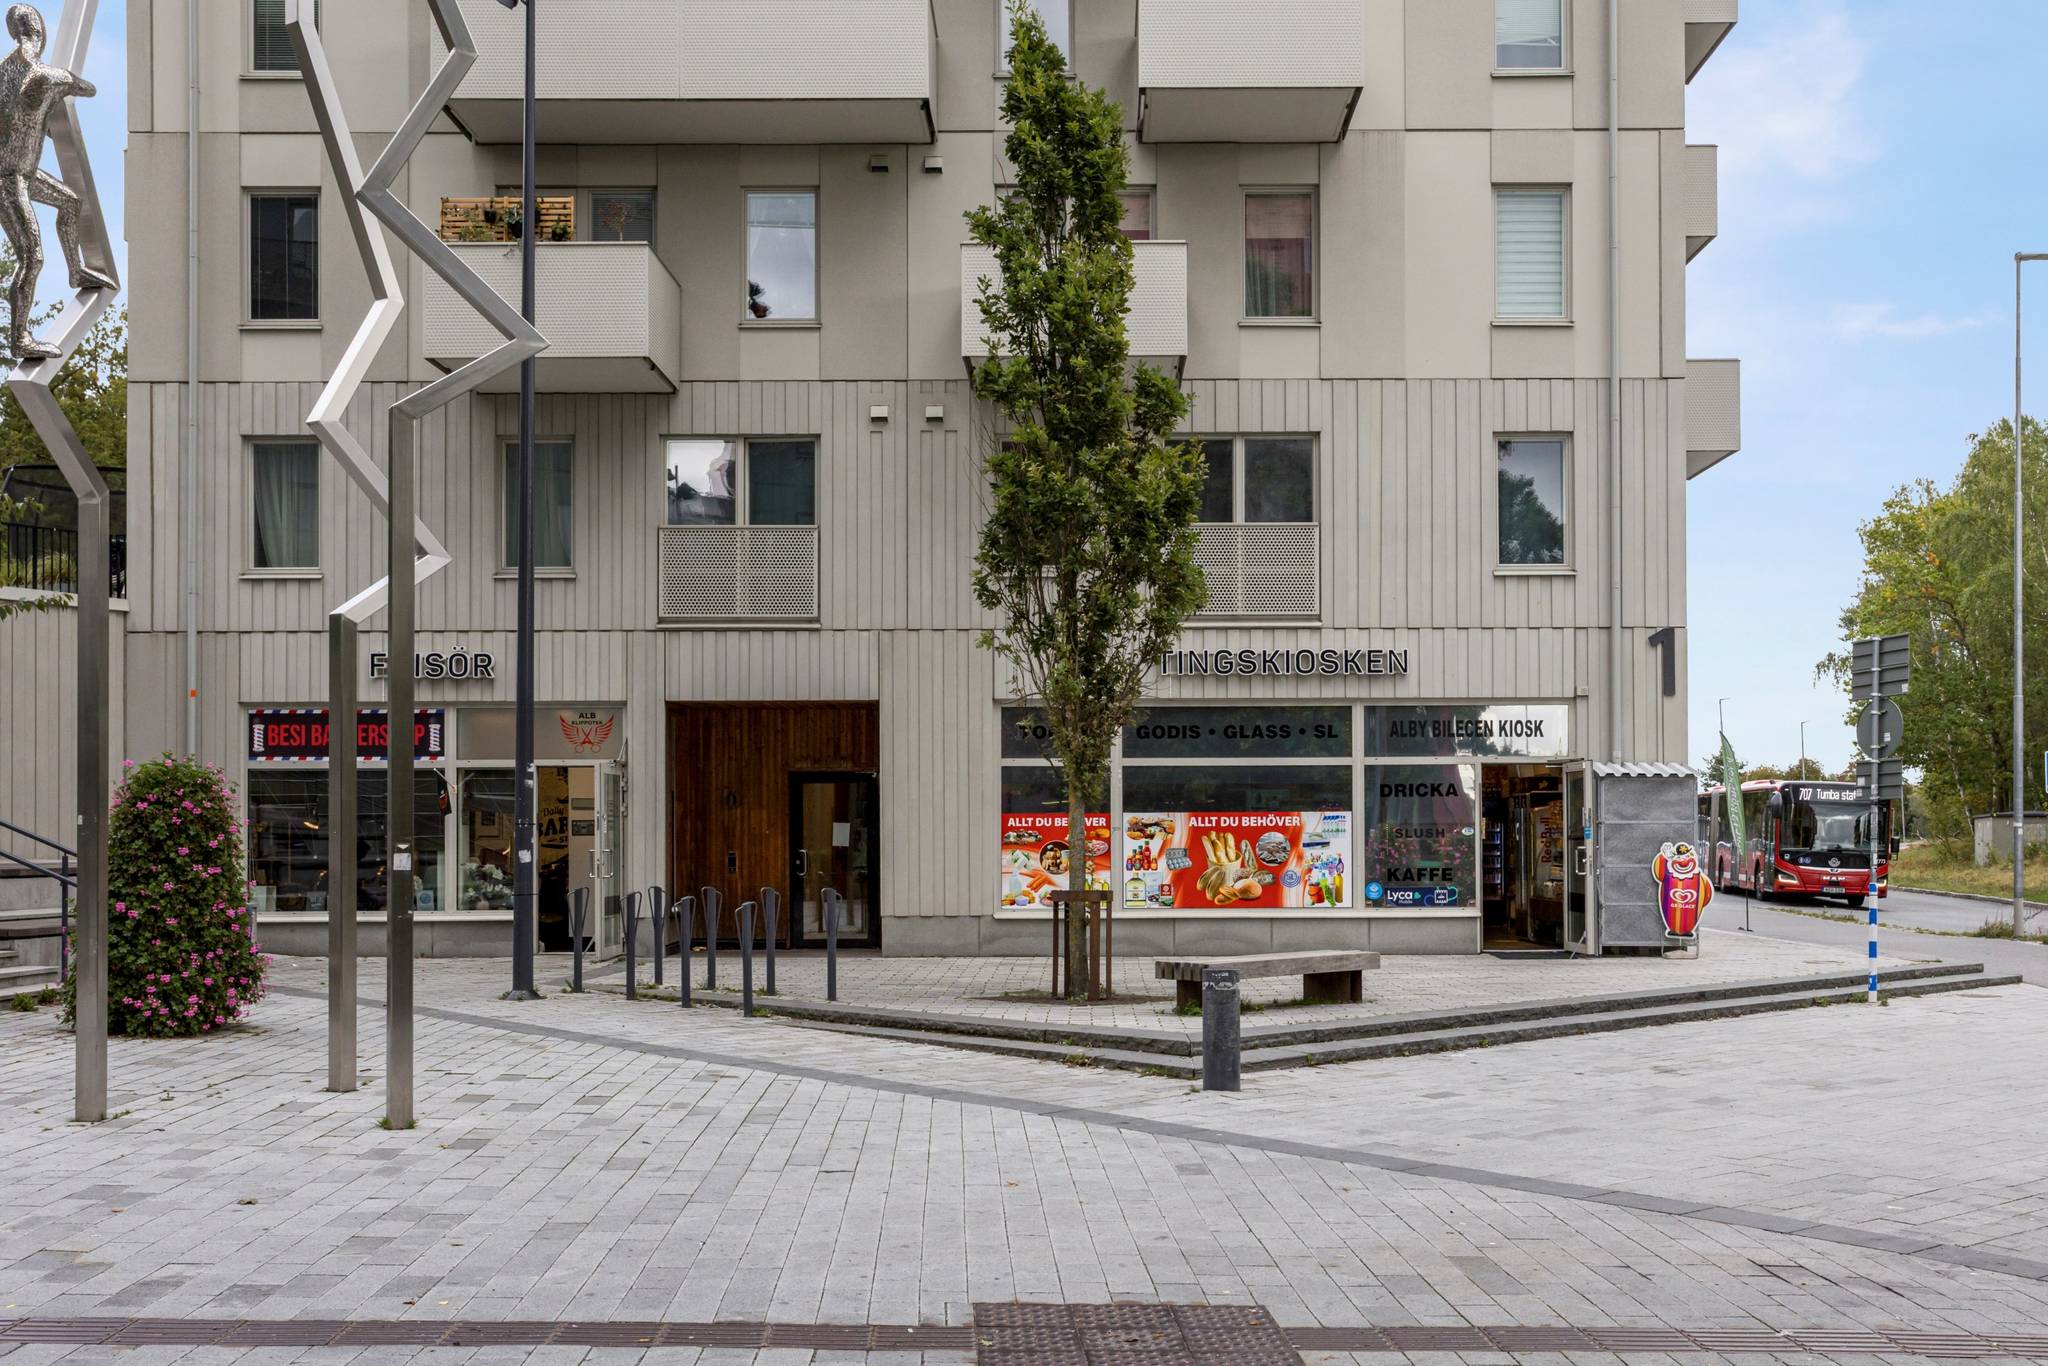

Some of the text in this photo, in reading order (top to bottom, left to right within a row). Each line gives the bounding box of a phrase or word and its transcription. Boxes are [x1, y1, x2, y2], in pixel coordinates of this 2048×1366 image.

[369, 644, 495, 679] FISÖR
[1649, 628, 1675, 696] 1
[268, 724, 425, 747] BESI BAERSP
[1136, 724, 1338, 739] GODIS GLASS SL
[1390, 720, 1427, 737] ALBY
[1499, 720, 1544, 737] KIOSK
[1380, 783, 1459, 798] DRICKA
[1799, 788, 1856, 800] 707 Tumba stat
[1008, 818, 1106, 826] ALLT DU BEVER
[1189, 814, 1301, 827] ALLT DU BEHÖVER
[1395, 828, 1445, 838] SLUSH
[1387, 867, 1453, 882] KAFFE
[1387, 890, 1413, 902] Lyca
